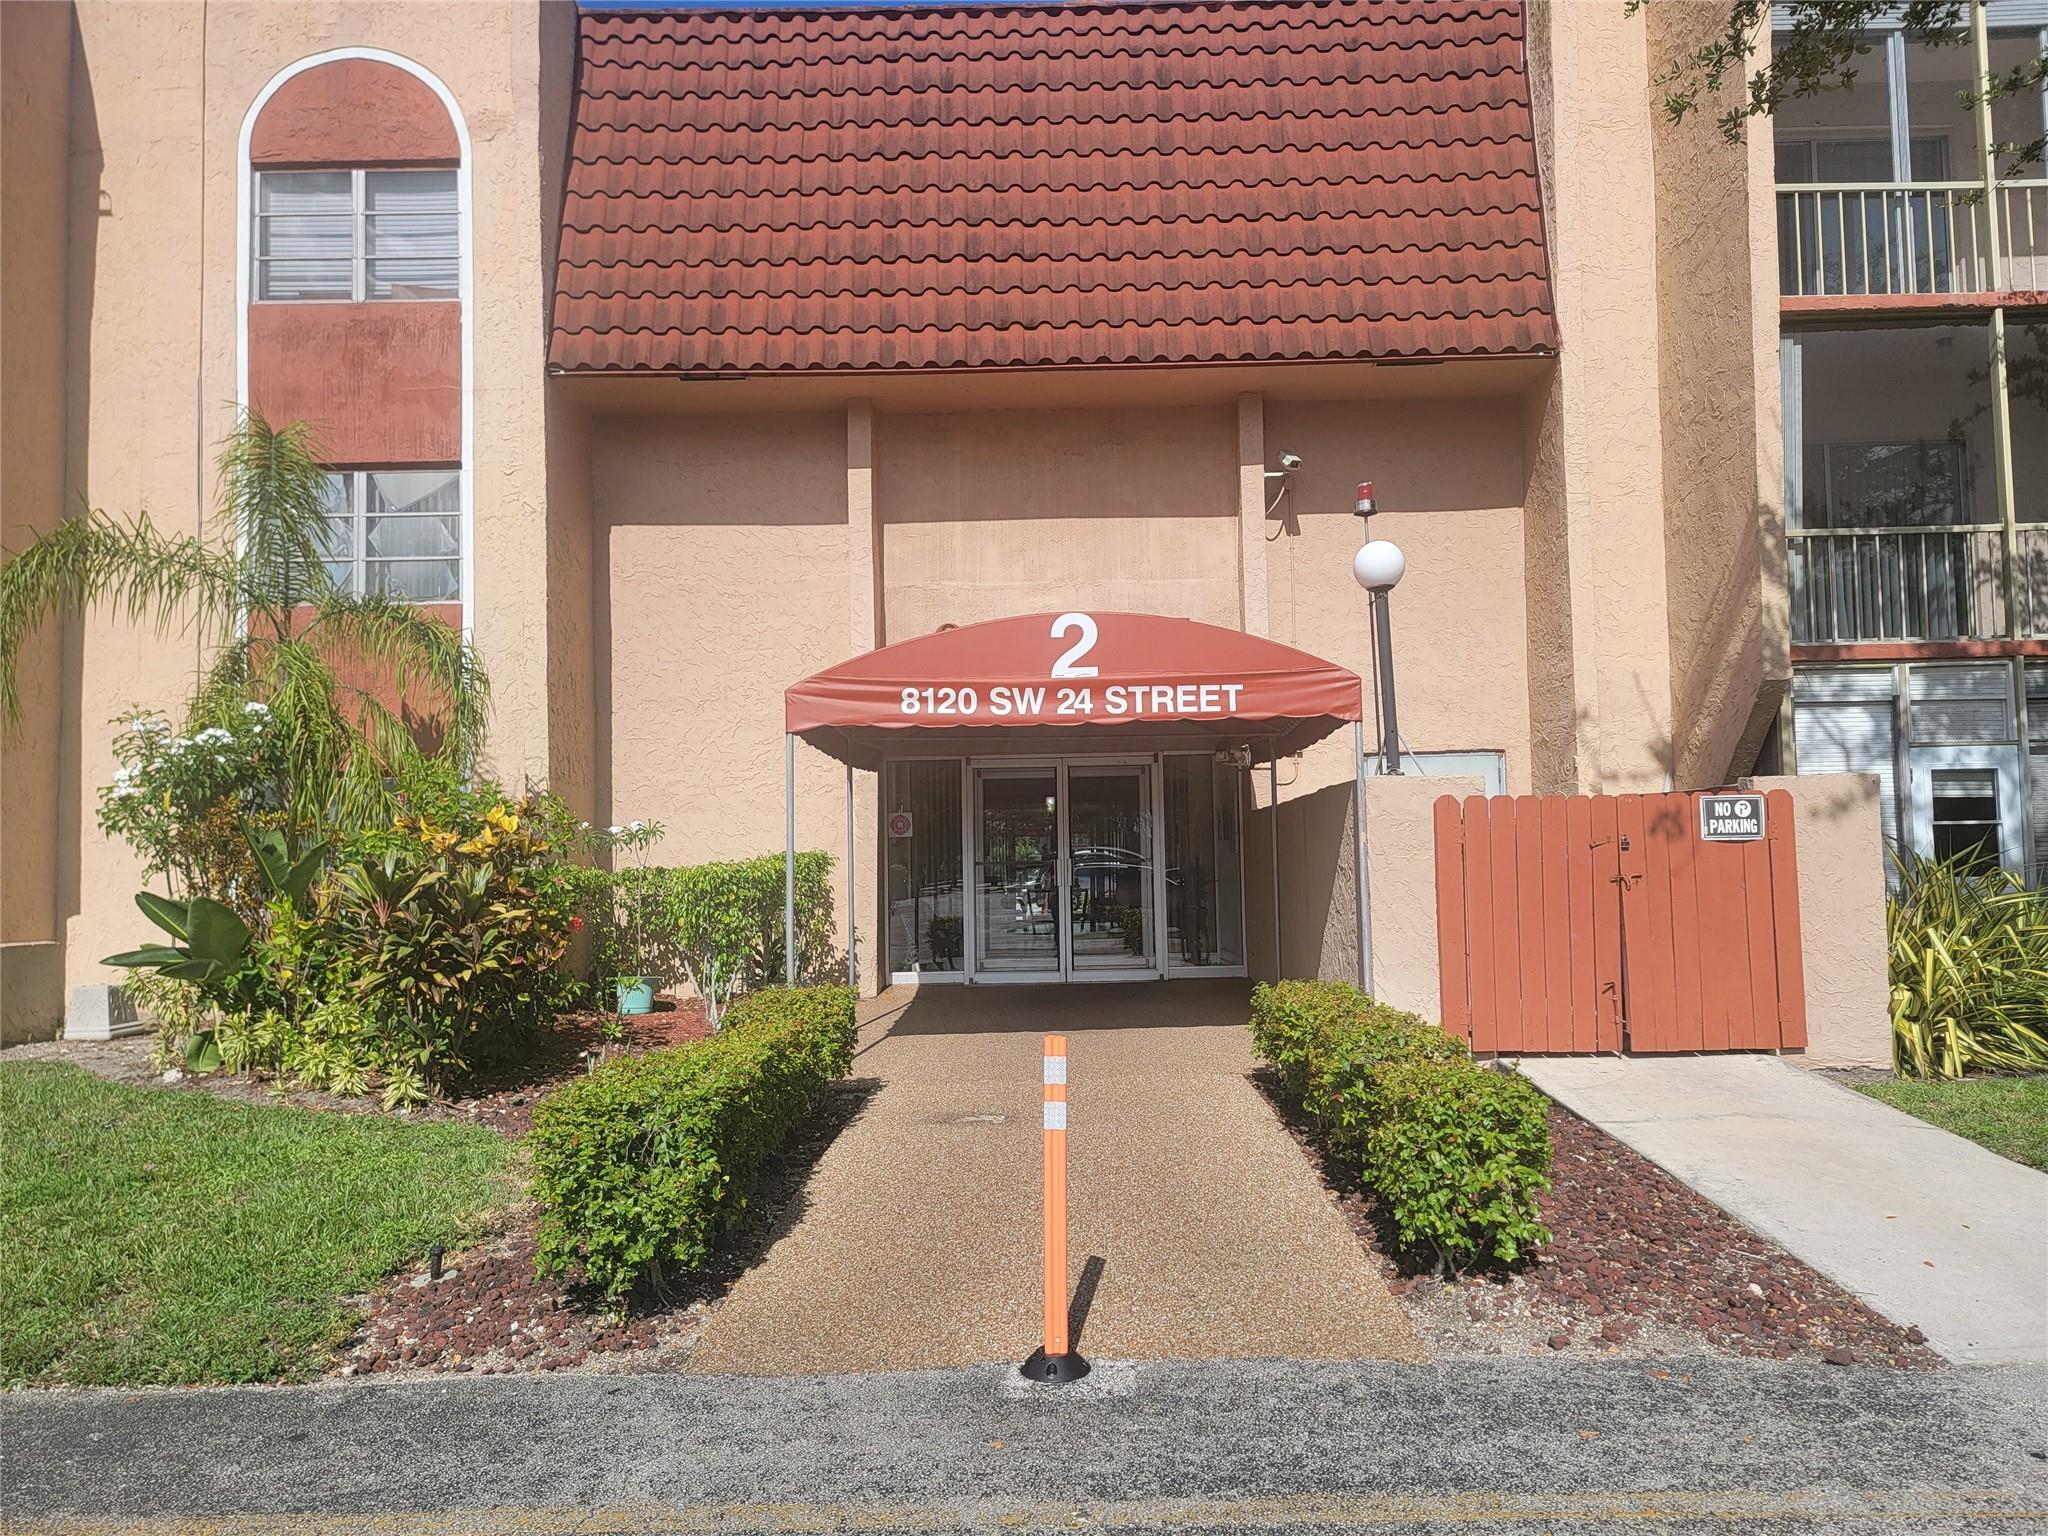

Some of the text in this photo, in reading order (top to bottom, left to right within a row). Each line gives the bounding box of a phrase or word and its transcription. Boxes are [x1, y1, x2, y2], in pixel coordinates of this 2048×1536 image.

[1050, 612, 1099, 679] 2
[901, 684, 1244, 716] 8120 SW 24 STREET
[1714, 802, 1731, 816] NO
[1709, 819, 1758, 833] PARKING
